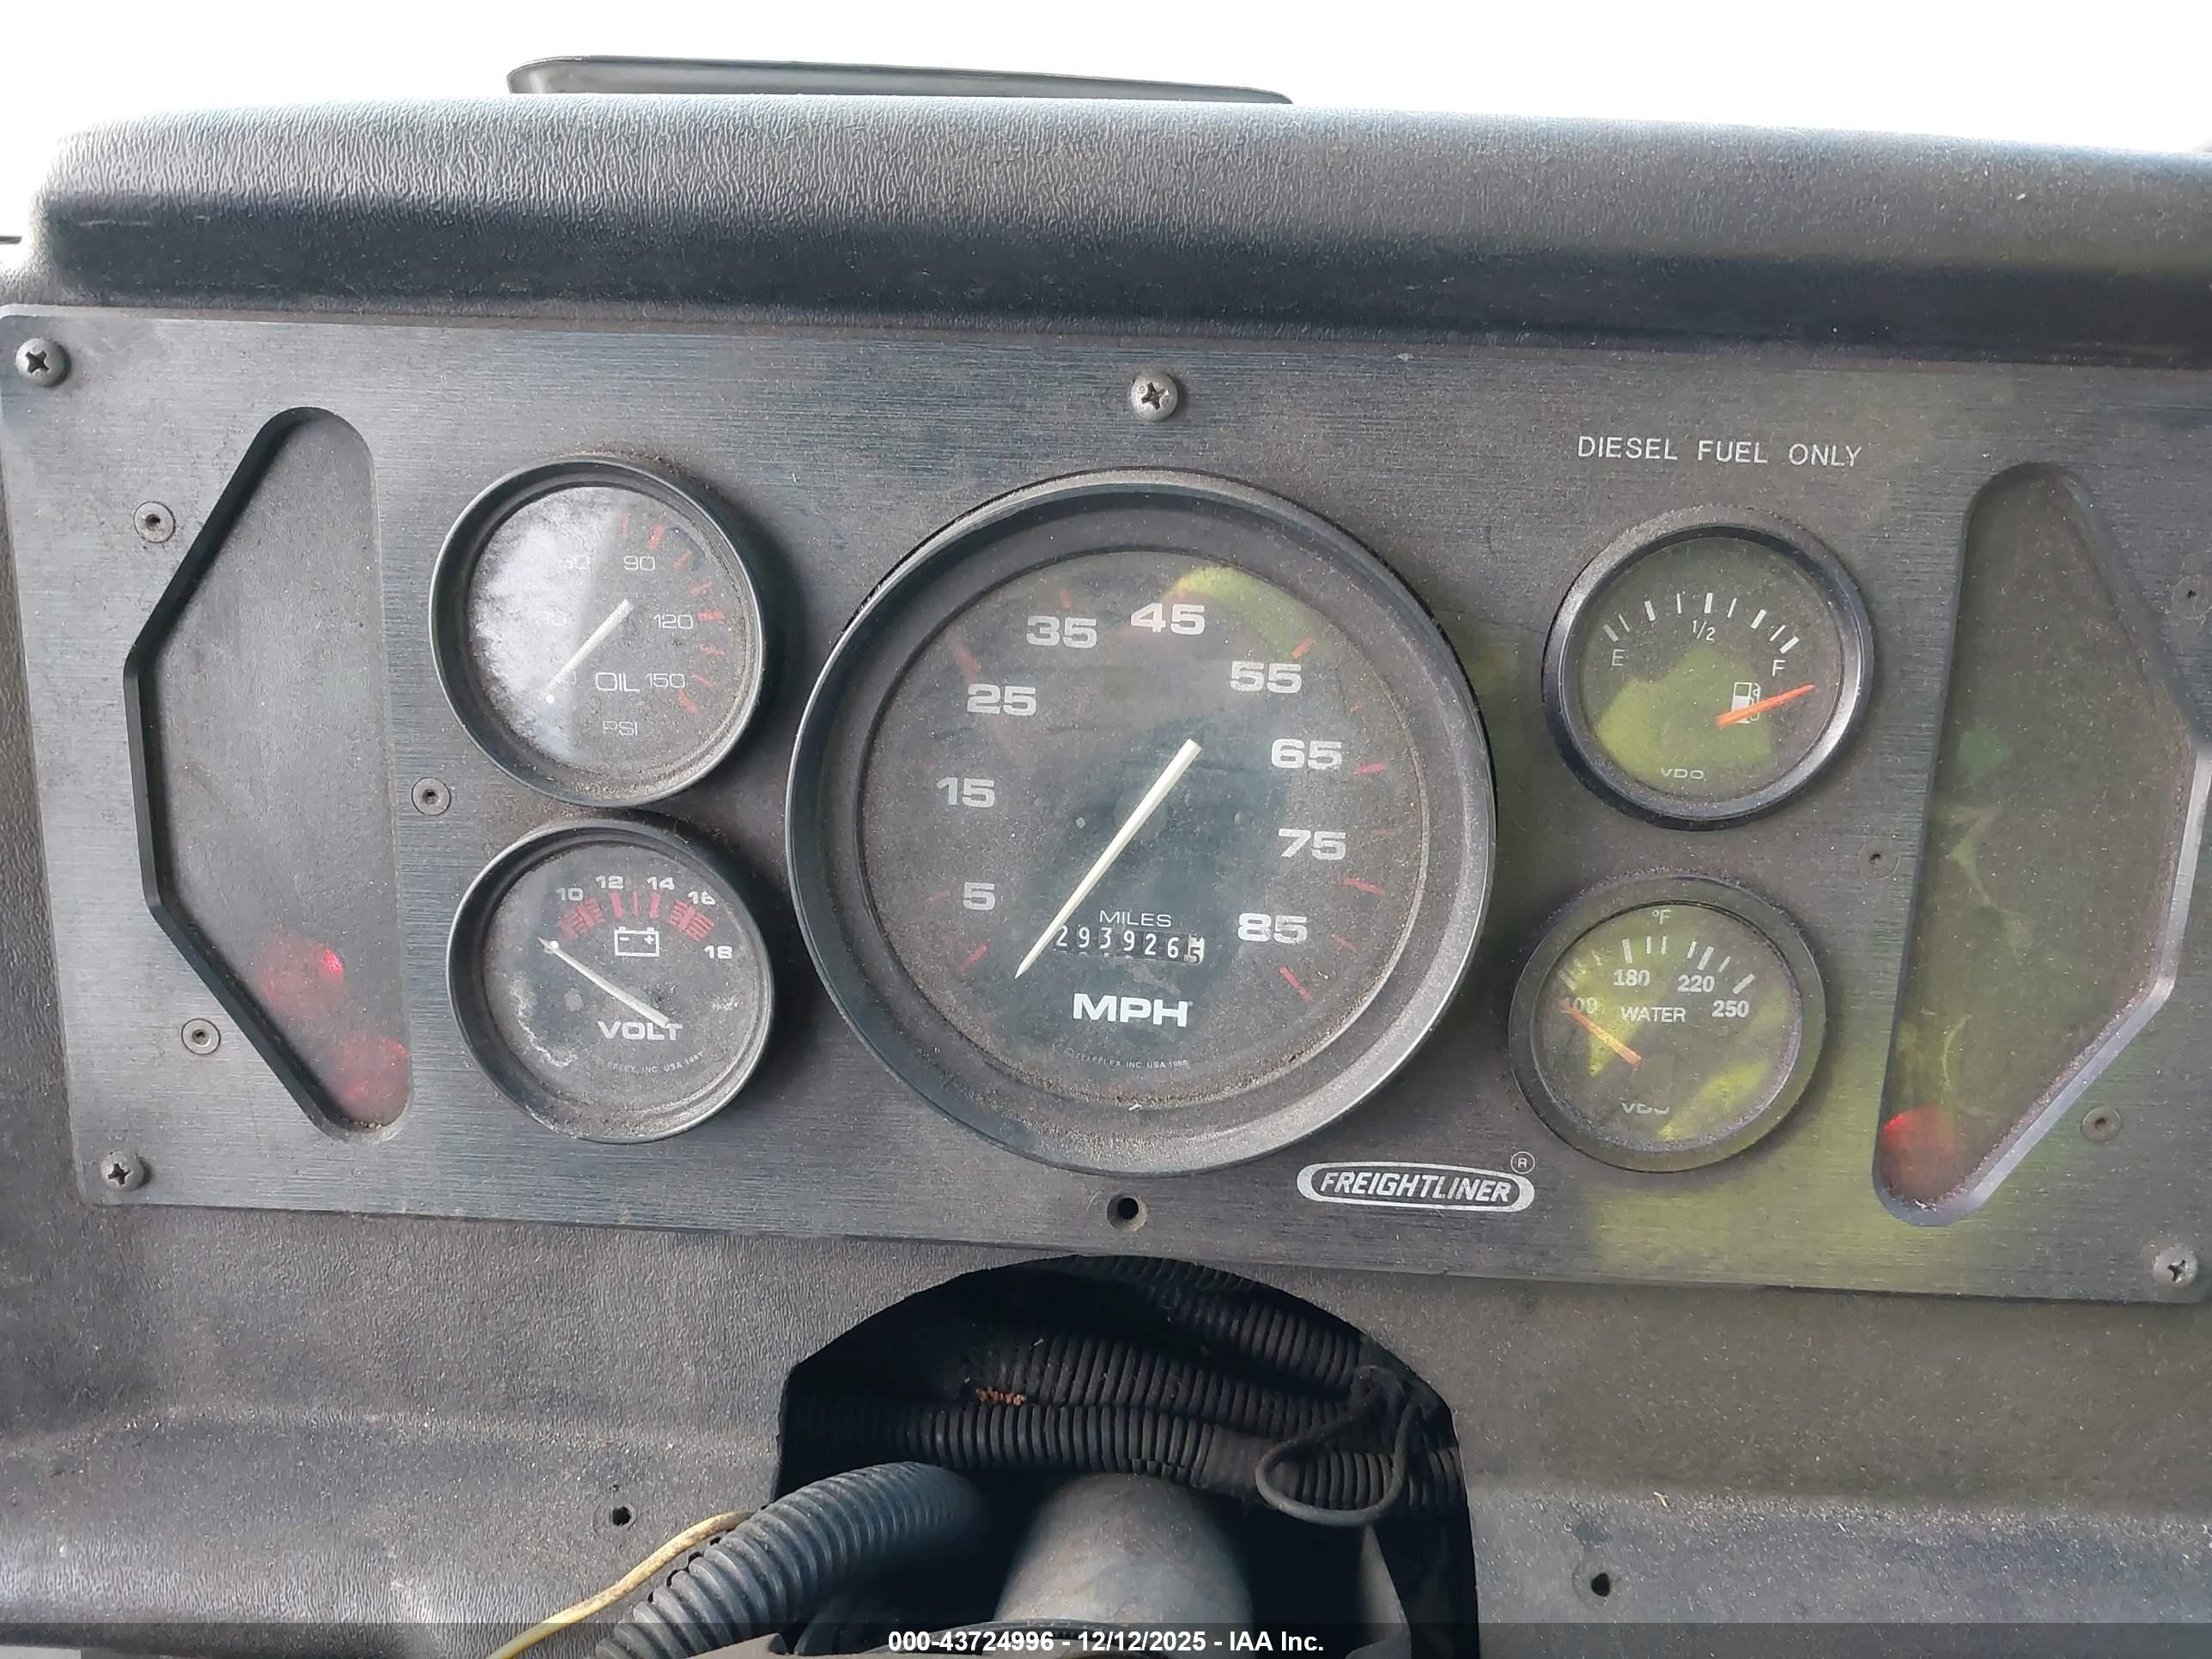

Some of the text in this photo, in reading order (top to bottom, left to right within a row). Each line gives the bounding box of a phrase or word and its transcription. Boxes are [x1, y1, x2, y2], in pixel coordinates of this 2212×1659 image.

[1577, 435, 1862, 467] DIESEL FUEL ONLY
[623, 555, 656, 571] 90
[653, 613, 694, 629] 120
[1131, 603, 1206, 635] 45
[1026, 615, 1097, 648] 35
[1611, 648, 1626, 666] E
[1230, 660, 1302, 694] 55
[1771, 659, 1787, 677] F
[595, 672, 641, 693] OIL
[645, 672, 685, 689] 150
[967, 684, 1036, 716] 25
[603, 720, 638, 736] PSI
[1271, 738, 1342, 770] 65
[1660, 767, 1705, 780] VDO
[936, 776, 996, 808] 15
[1278, 828, 1346, 860] 75
[595, 875, 624, 890] 12
[646, 876, 675, 890] 14
[556, 888, 584, 902] 10
[688, 890, 716, 906] 16
[963, 881, 996, 911] 5
[1099, 909, 1172, 928] MILES
[1237, 912, 1308, 945] 85
[704, 945, 733, 959] 18
[1613, 969, 1650, 987] 180
[1677, 975, 1716, 993] 220
[1073, 993, 1189, 1027] MPH
[1620, 1006, 1686, 1024] WATER
[1711, 1000, 1750, 1018] 250
[598, 1020, 684, 1041] VOLT
[1320, 1170, 1512, 1203] FREIGHTLINER
